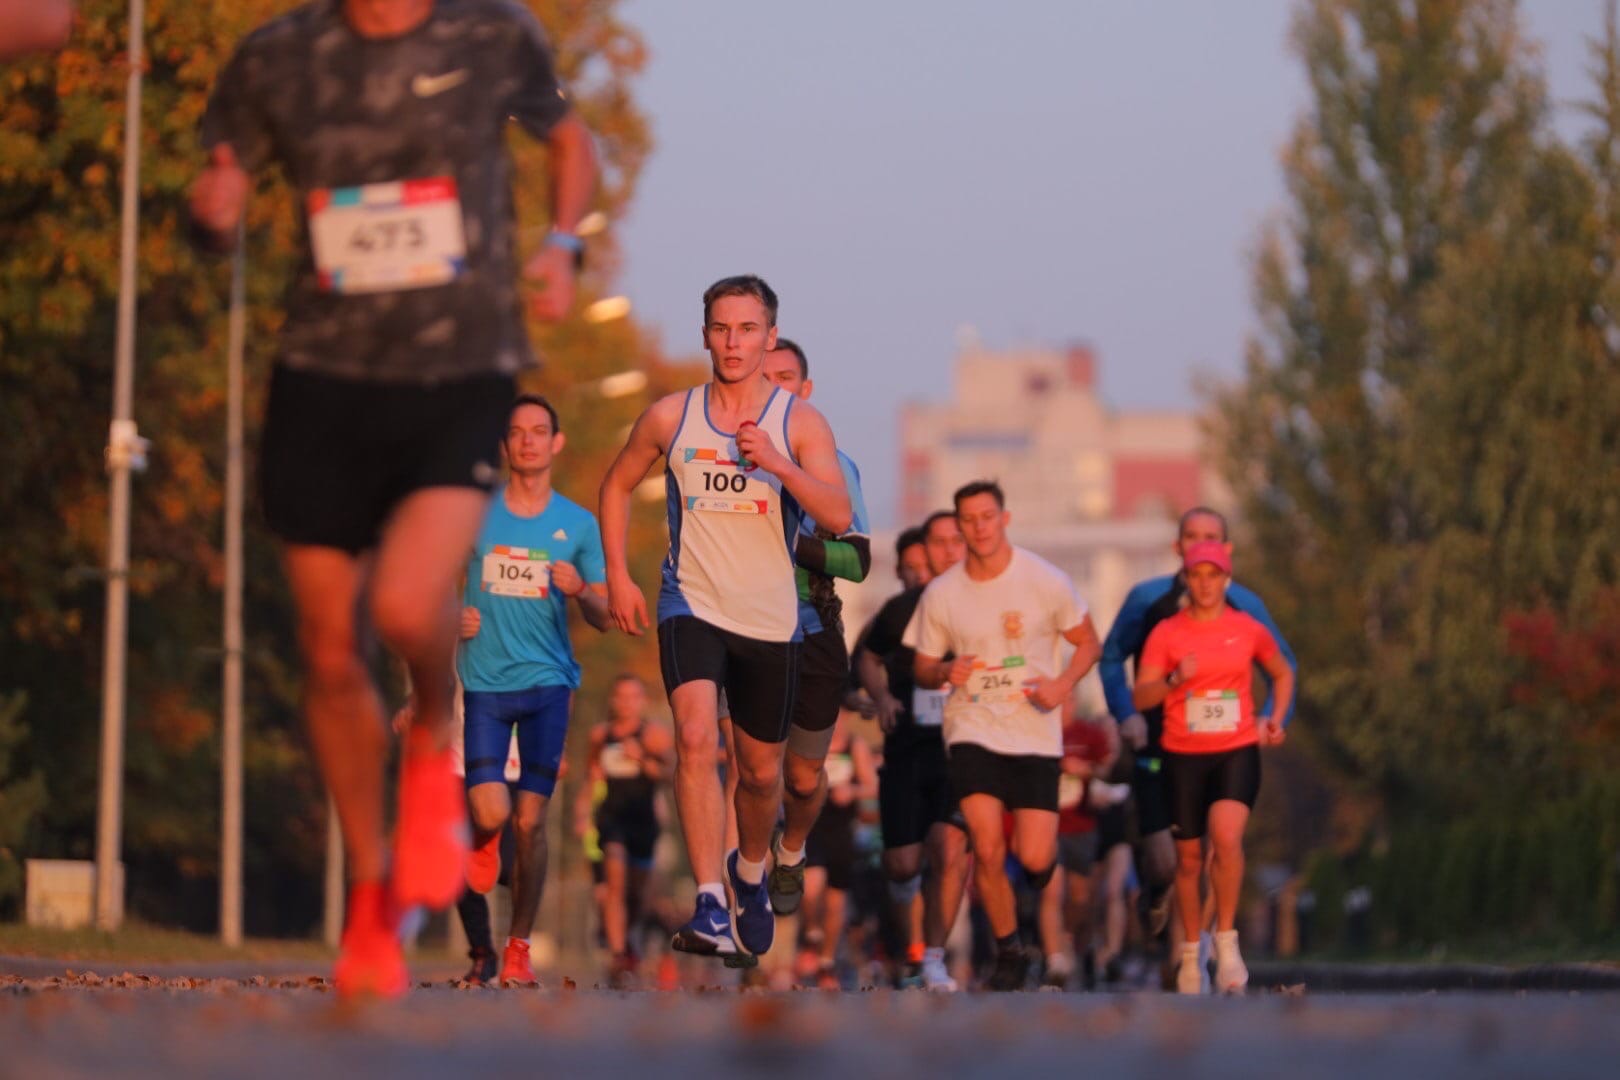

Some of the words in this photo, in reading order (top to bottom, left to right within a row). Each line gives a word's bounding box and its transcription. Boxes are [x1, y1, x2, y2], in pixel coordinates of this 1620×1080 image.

[702, 471, 747, 493] 100
[499, 563, 533, 581] 104
[1203, 704, 1225, 719] 39
